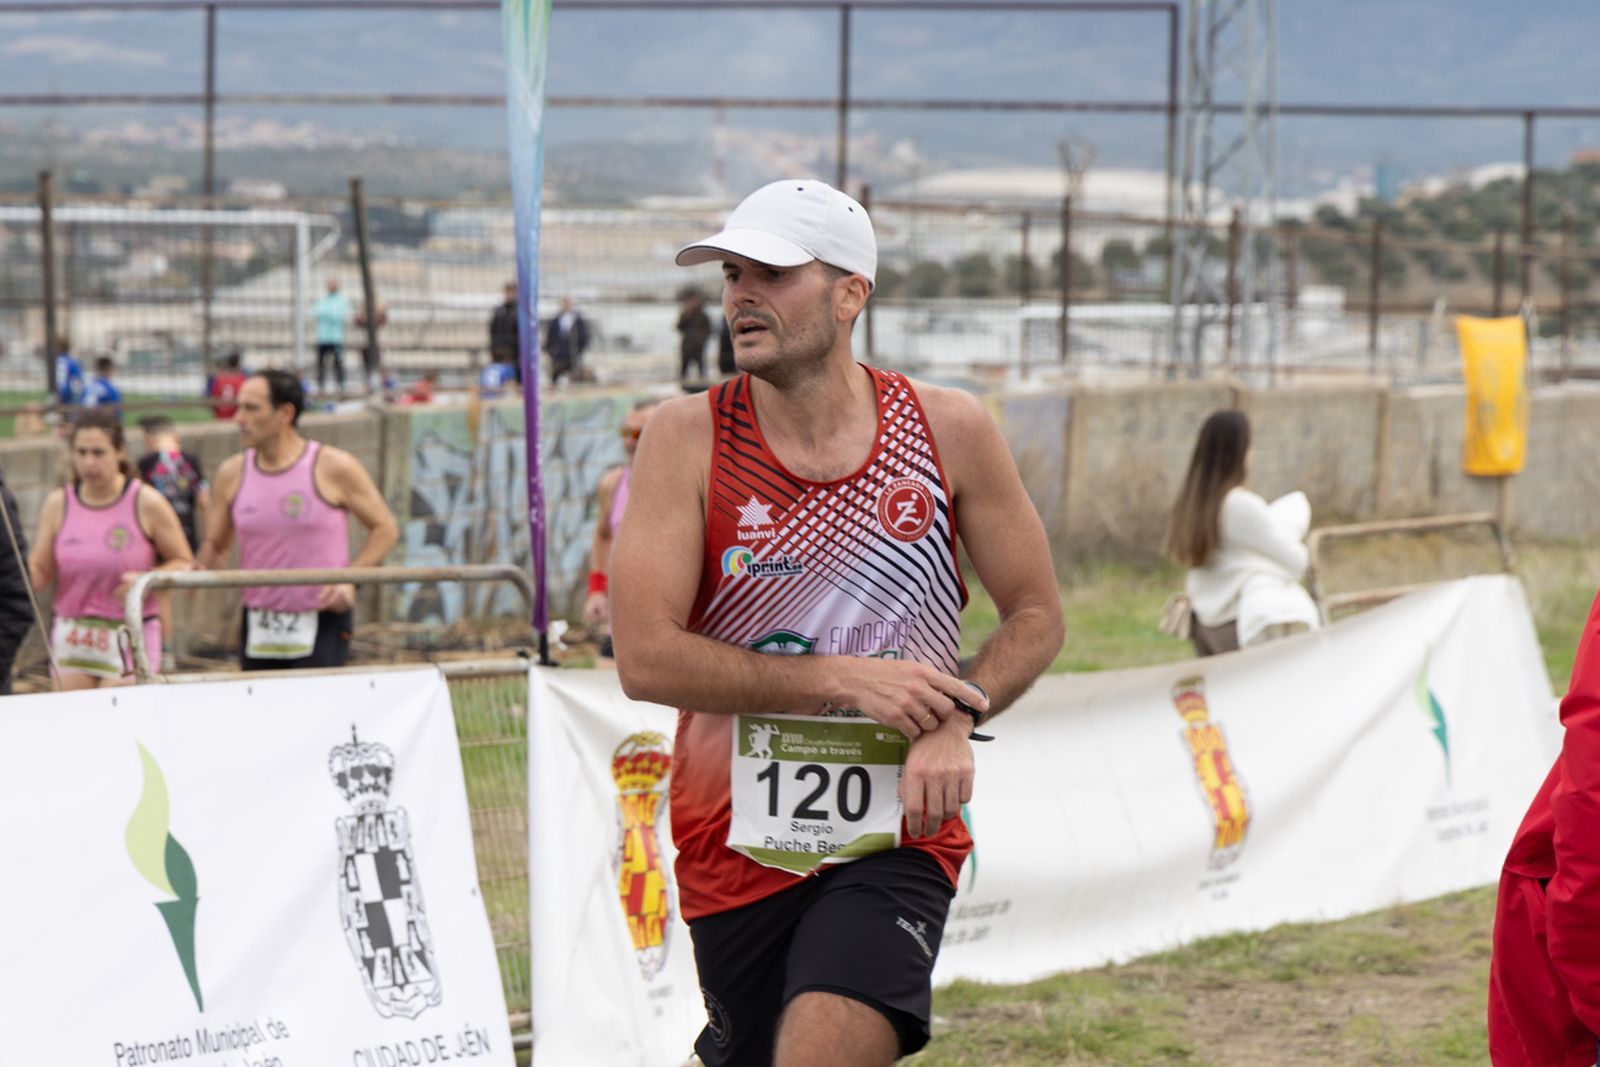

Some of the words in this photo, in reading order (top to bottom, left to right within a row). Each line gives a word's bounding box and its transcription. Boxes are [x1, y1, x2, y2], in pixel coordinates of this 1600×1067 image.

[737, 528, 776, 541] luanvi
[780, 743, 819, 756] Campo
[756, 761, 872, 822] 120
[790, 820, 834, 837] Sergio
[764, 835, 812, 853] Puche
[113, 1034, 193, 1067] Patronato
[195, 1018, 267, 1054] Municipal
[266, 1016, 290, 1040] de
[353, 1040, 421, 1067] CIUDAD
[421, 1034, 450, 1064] DE
